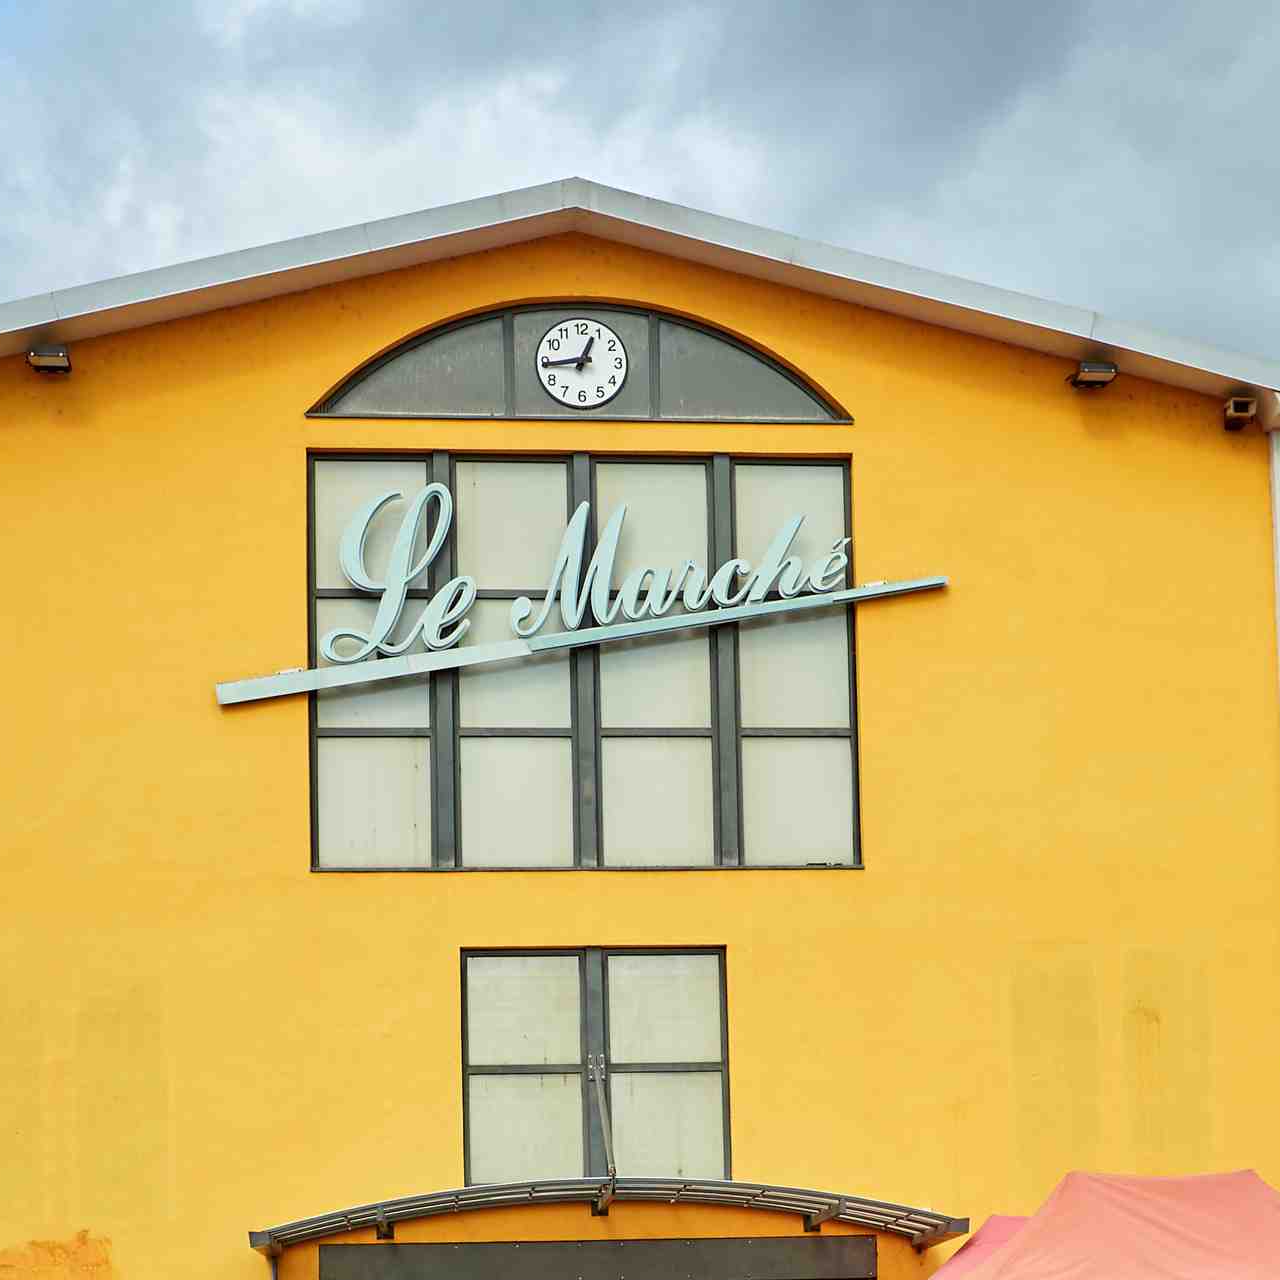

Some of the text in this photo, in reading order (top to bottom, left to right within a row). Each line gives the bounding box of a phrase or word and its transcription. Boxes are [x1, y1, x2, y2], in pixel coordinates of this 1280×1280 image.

[557, 327, 569, 340] 11
[574, 323, 589, 336] 12
[595, 327, 601, 340] 1
[545, 338, 560, 351] 10
[607, 339, 617, 352] 2
[614, 357, 623, 370] 3
[547, 374, 556, 386] 8
[607, 375, 617, 388] 4
[560, 385, 569, 398] 7
[578, 390, 587, 403] 6
[596, 386, 605, 399] 5
[321, 482, 852, 665] Le Marché
